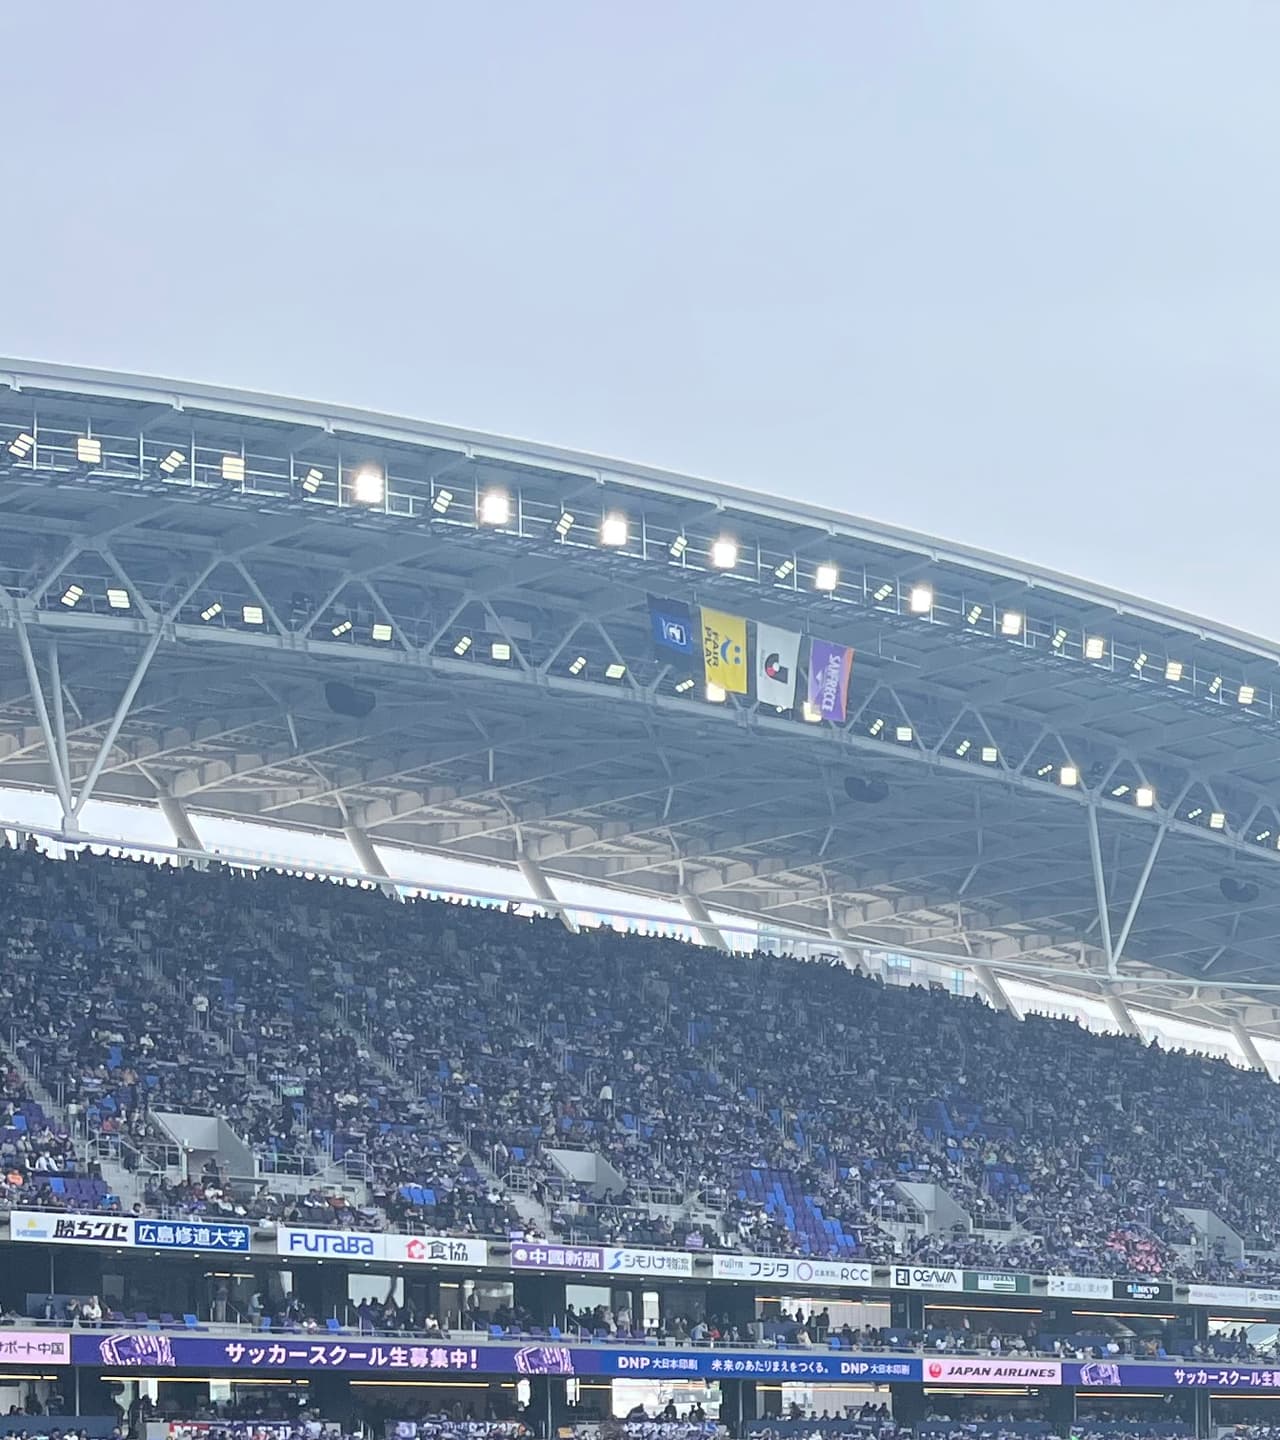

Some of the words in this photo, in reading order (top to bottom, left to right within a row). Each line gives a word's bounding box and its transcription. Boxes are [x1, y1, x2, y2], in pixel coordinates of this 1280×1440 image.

[138, 1224, 246, 1247] 広島修道大学
[428, 1239, 469, 1261] 食協
[750, 1262, 790, 1278] フジタ
[840, 1267, 870, 1281] RCC
[913, 1268, 957, 1284] OGAWA
[226, 1343, 479, 1369] サッカースクール生募集中!
[618, 1357, 650, 1370] DNP
[652, 1358, 698, 1371] 大日本印刷
[840, 1363, 869, 1375] DNP
[947, 1366, 992, 1376] JAPAN
[994, 1367, 1056, 1378] AIRLINES
